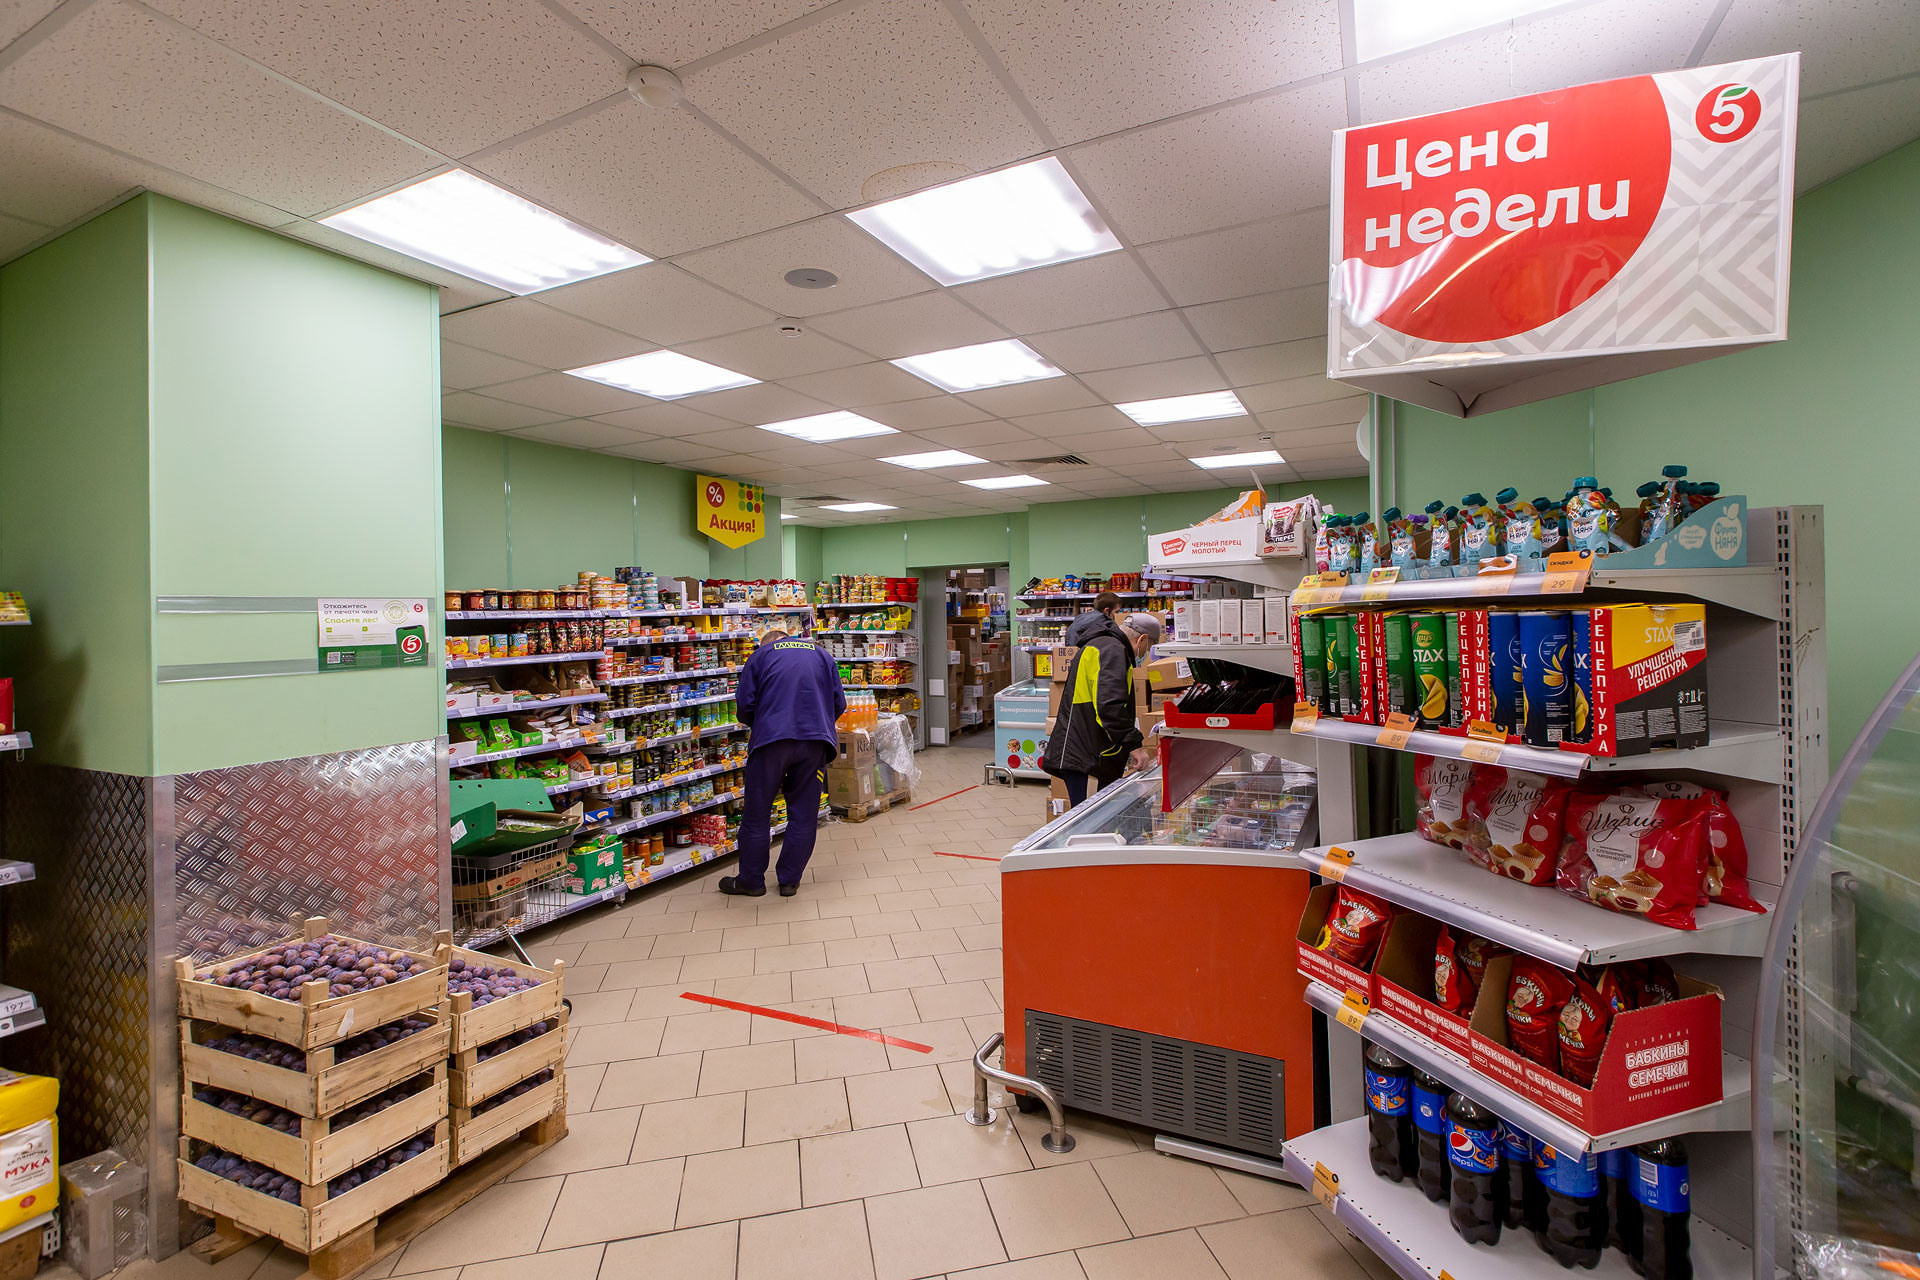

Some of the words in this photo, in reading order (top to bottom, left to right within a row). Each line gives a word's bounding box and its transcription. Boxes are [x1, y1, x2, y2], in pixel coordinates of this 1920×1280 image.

[1708, 86, 1750, 135] 5
[1365, 120, 1549, 191] Цена
[1363, 179, 1631, 252] недели
[709, 513, 756, 534] Акция!
[1191, 547, 1227, 555] МОЛОТЫЙ
[1715, 536, 1738, 550] НЯНЯ
[406, 636, 418, 651] 5
[1644, 626, 1675, 643] STAX
[1358, 612, 1370, 721] РЕЦЕПТУРА
[1413, 648, 1445, 663] STAX
[1374, 613, 1386, 723] УЛУЧШЕННАЯ
[1637, 656, 1689, 692] РЕЦЕПТУРА
[1594, 609, 1609, 752] РЕЦЕПТУРА
[857, 736, 876, 753] Rich
[1390, 734, 1402, 743] 89
[1341, 898, 1379, 922] БАБКИНЫ
[1332, 919, 1361, 939] СЕМЕЧКИ
[1299, 945, 1333, 971] БАБКИНЫ
[1333, 963, 1369, 989] СЕМЕЧКИ
[3, 1001, 24, 1013] 197
[1380, 984, 1423, 1016] БАБКИНЫ
[1423, 1008, 1470, 1040] СЕМЕЧКИ
[1347, 1014, 1358, 1024] 89
[1625, 1039, 1690, 1070] БАБКИНЫ
[1470, 1037, 1523, 1076] БАБКИНЫ
[1524, 1068, 1583, 1108] СЕМЕЧКИ
[1628, 1059, 1689, 1089] СЕМЕЧКИ
[5, 1156, 51, 1179] МУКА
[1451, 1153, 1474, 1168] pepsi
